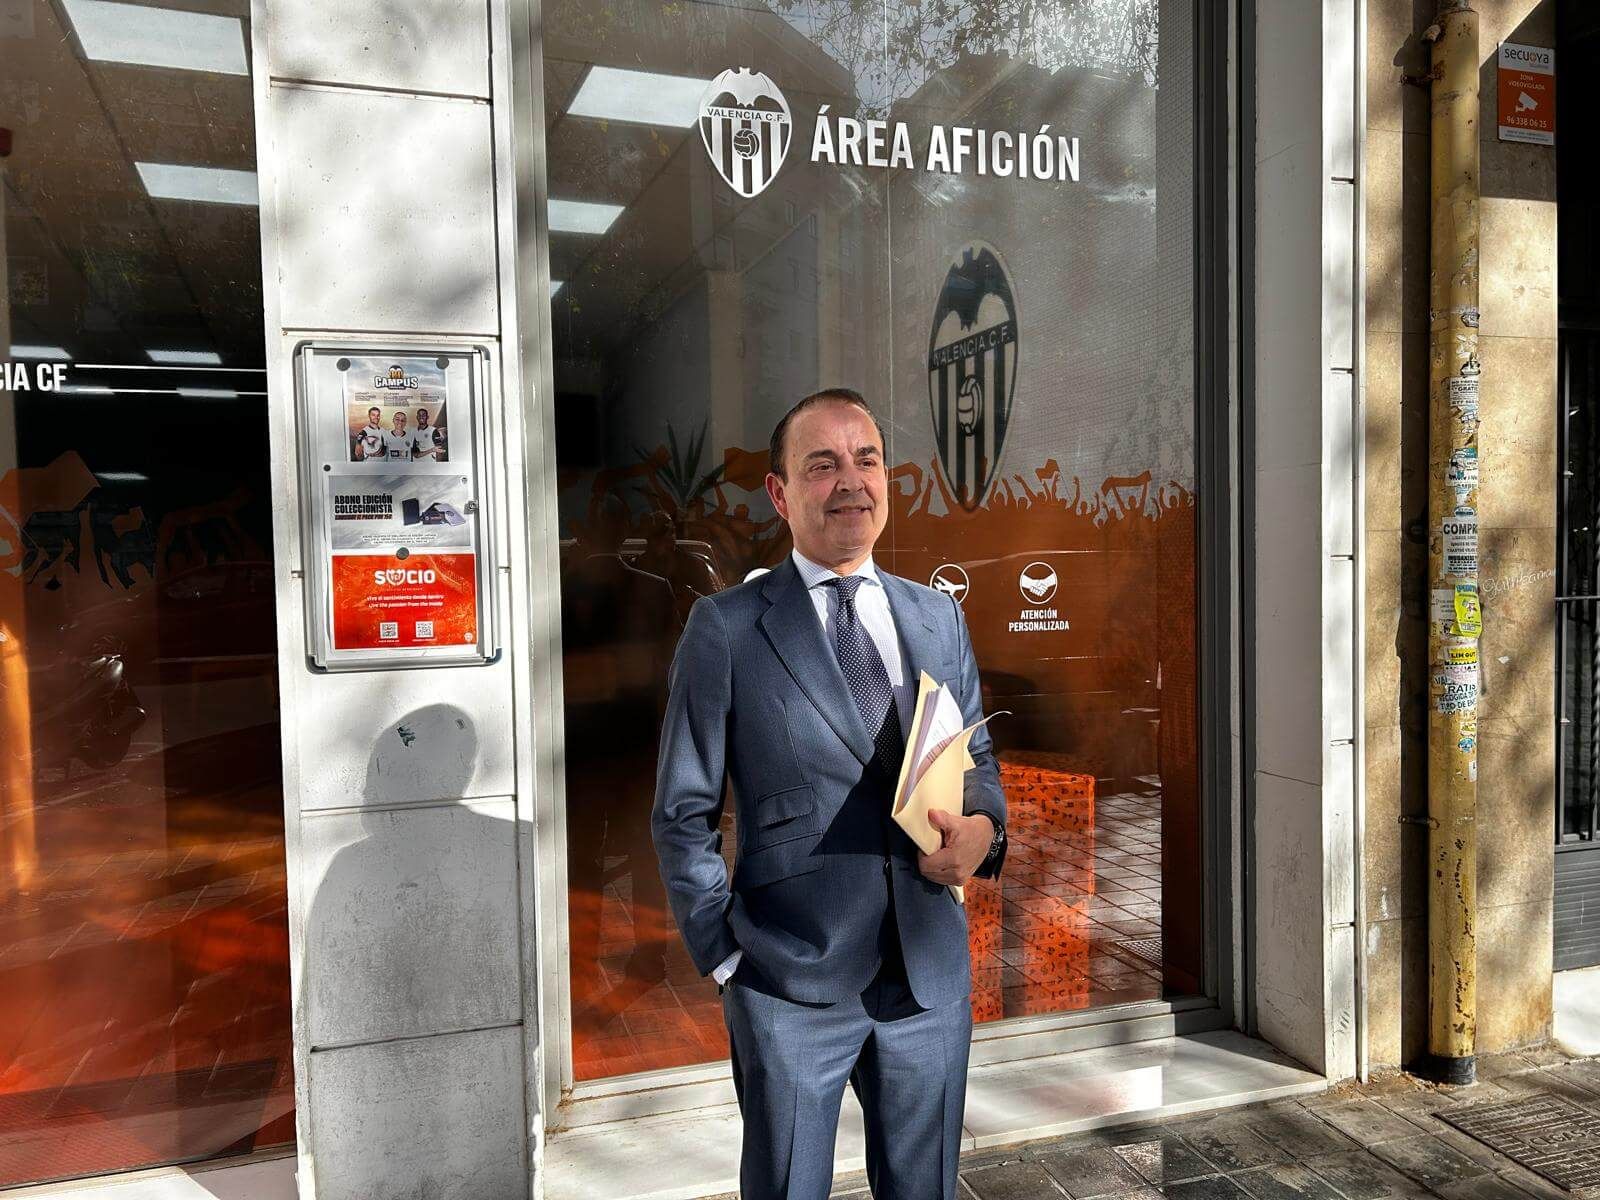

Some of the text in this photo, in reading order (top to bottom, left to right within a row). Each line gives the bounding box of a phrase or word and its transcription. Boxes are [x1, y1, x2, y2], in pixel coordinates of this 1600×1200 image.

[707, 108, 785, 122] VALENCIA C.F.
[810, 104, 1080, 182] ÁREA AFICIÓN
[933, 335, 986, 366] VALENCIA
[37, 363, 67, 392] CF
[375, 376, 418, 389] CAMPUS
[335, 493, 392, 504] ABONO EDICIÓN
[335, 504, 392, 513] COLECCIONISTA
[1020, 608, 1058, 619] ATENCIÓN
[1008, 620, 1070, 632] PERSONALIZADA
